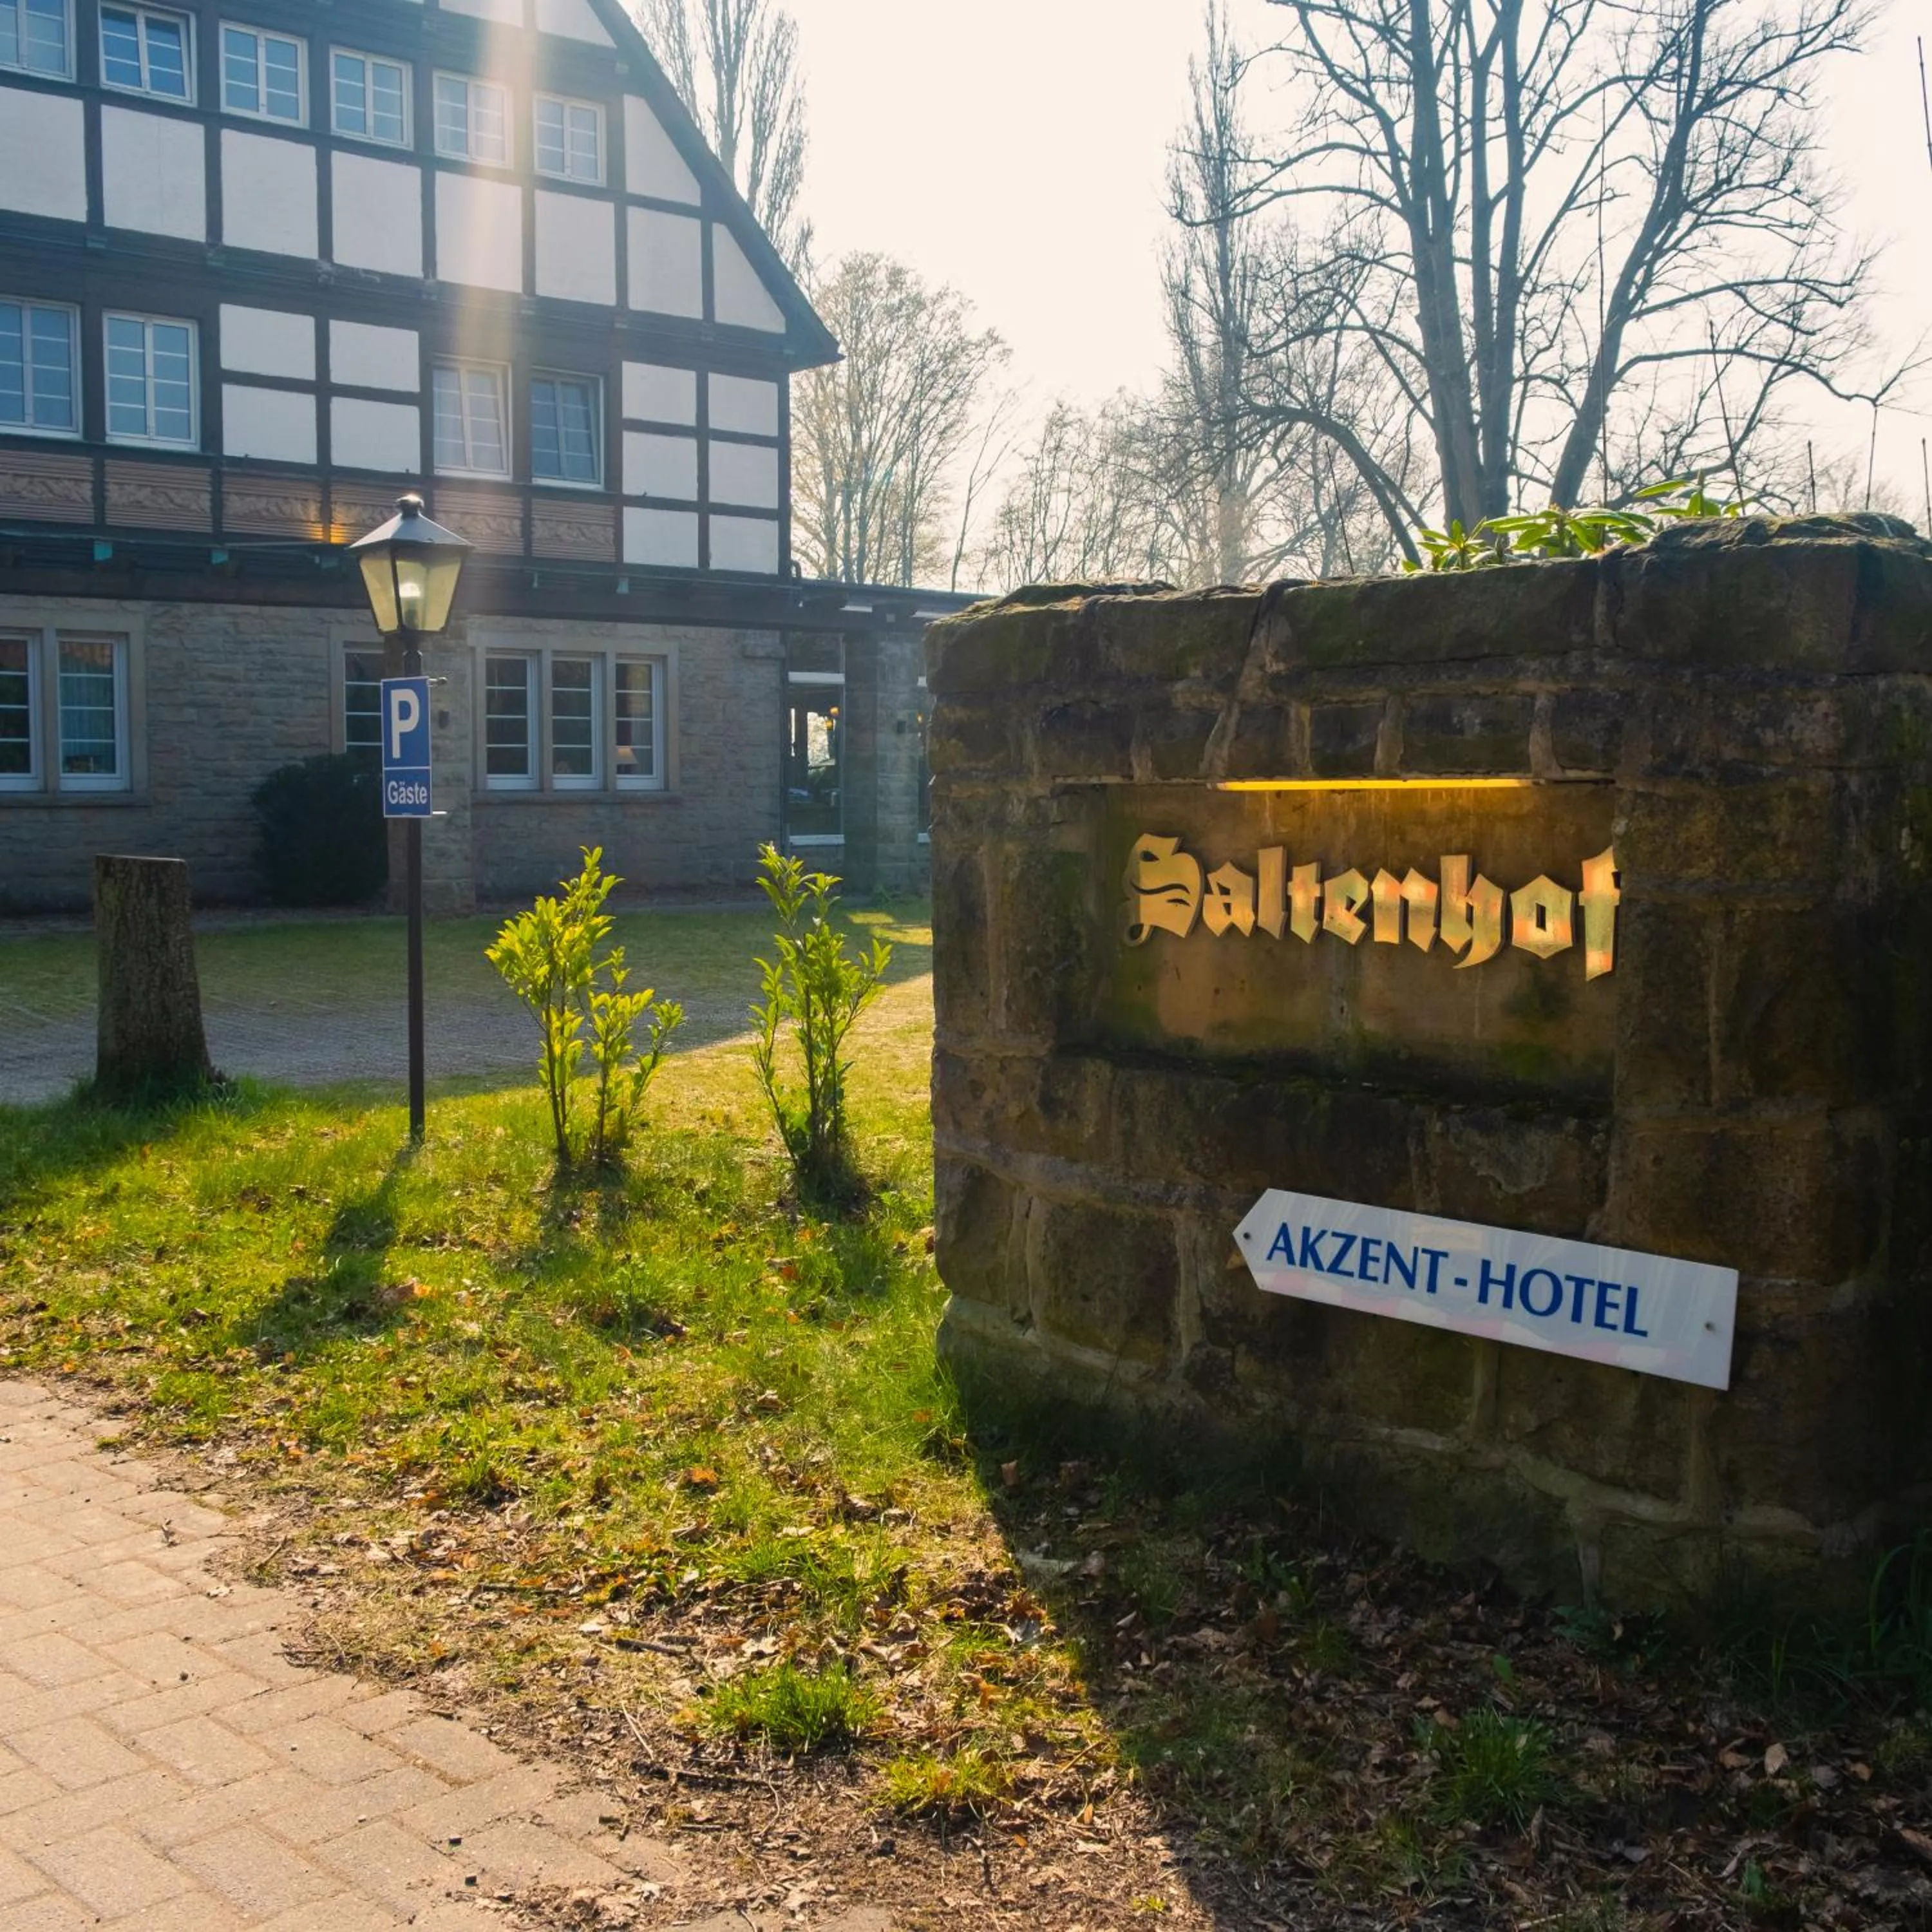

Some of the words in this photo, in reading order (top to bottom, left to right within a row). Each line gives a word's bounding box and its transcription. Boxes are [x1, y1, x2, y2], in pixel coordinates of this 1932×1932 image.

[390, 688, 420, 759] P
[388, 780, 428, 804] Gäste
[1123, 833, 1621, 981] Saltenhof
